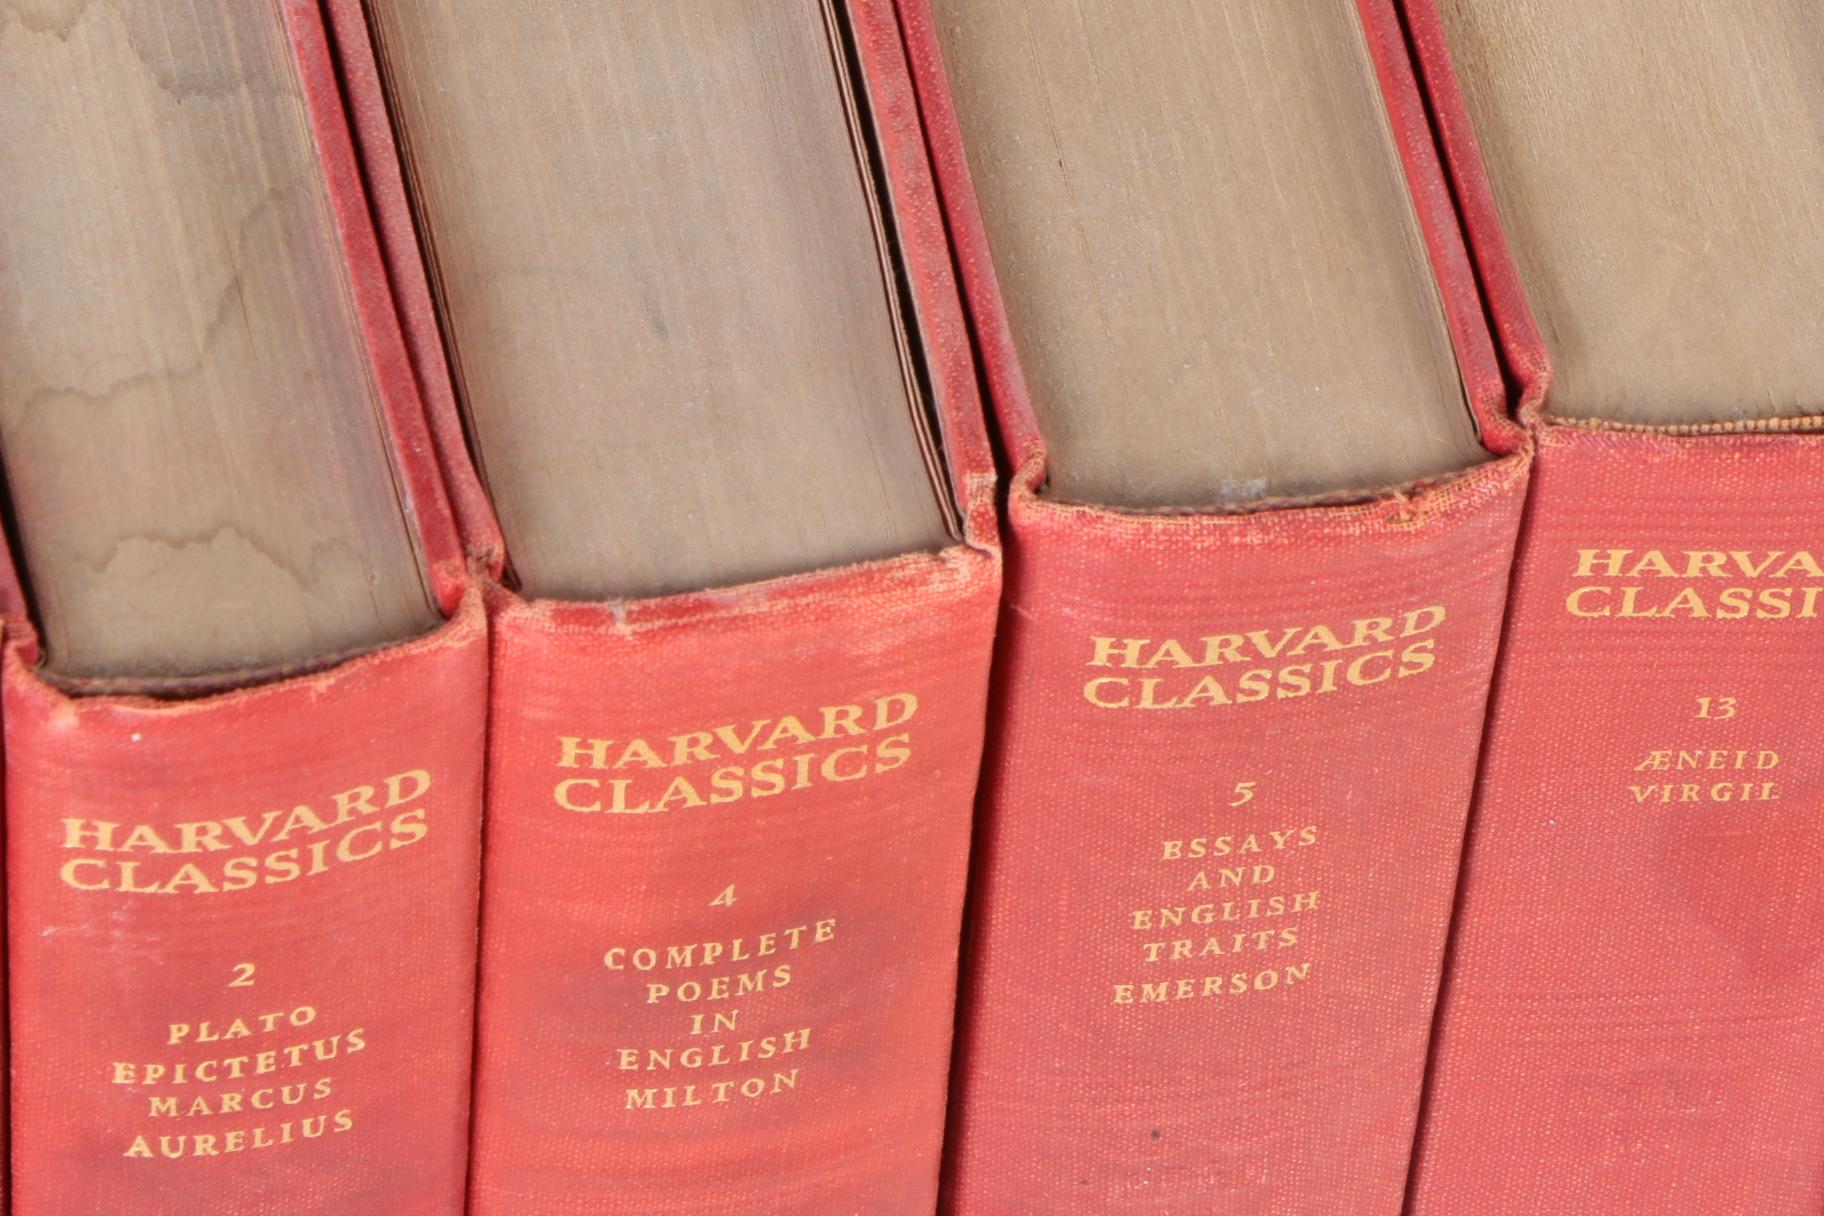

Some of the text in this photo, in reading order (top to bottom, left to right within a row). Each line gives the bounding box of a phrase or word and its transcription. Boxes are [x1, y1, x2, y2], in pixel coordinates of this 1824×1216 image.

[1087, 606, 1445, 668] HARVARD
[1083, 639, 1436, 710] CLASSICS
[1694, 696, 1738, 720] 13
[557, 693, 918, 770] HARVARD
[553, 733, 912, 814] CLASSICS
[1635, 750, 1780, 772] ÆNEID
[61, 770, 431, 852] HARVARD
[1229, 782, 1256, 806] 5
[1630, 782, 1781, 803] VIRGIL
[60, 810, 429, 893] CLASSICS
[1161, 825, 1319, 859] ESSAYS
[709, 884, 738, 907] 4
[1187, 864, 1276, 890] AND
[1131, 891, 1321, 930] ENGLISH
[604, 918, 838, 971] COMPLETE
[1143, 928, 1299, 962] TRAITS
[228, 963, 256, 987] 2
[646, 965, 792, 1004] POEMS
[1112, 963, 1312, 1005] EMERSON
[169, 1006, 316, 1044] PLATO
[691, 1011, 738, 1035] IN
[112, 1028, 366, 1085] EPICTETUS
[618, 1028, 812, 1070] ENGLISH
[148, 1078, 334, 1117] MARCUS
[625, 1069, 800, 1110] MILTON
[123, 1111, 354, 1157] AURELIUS
